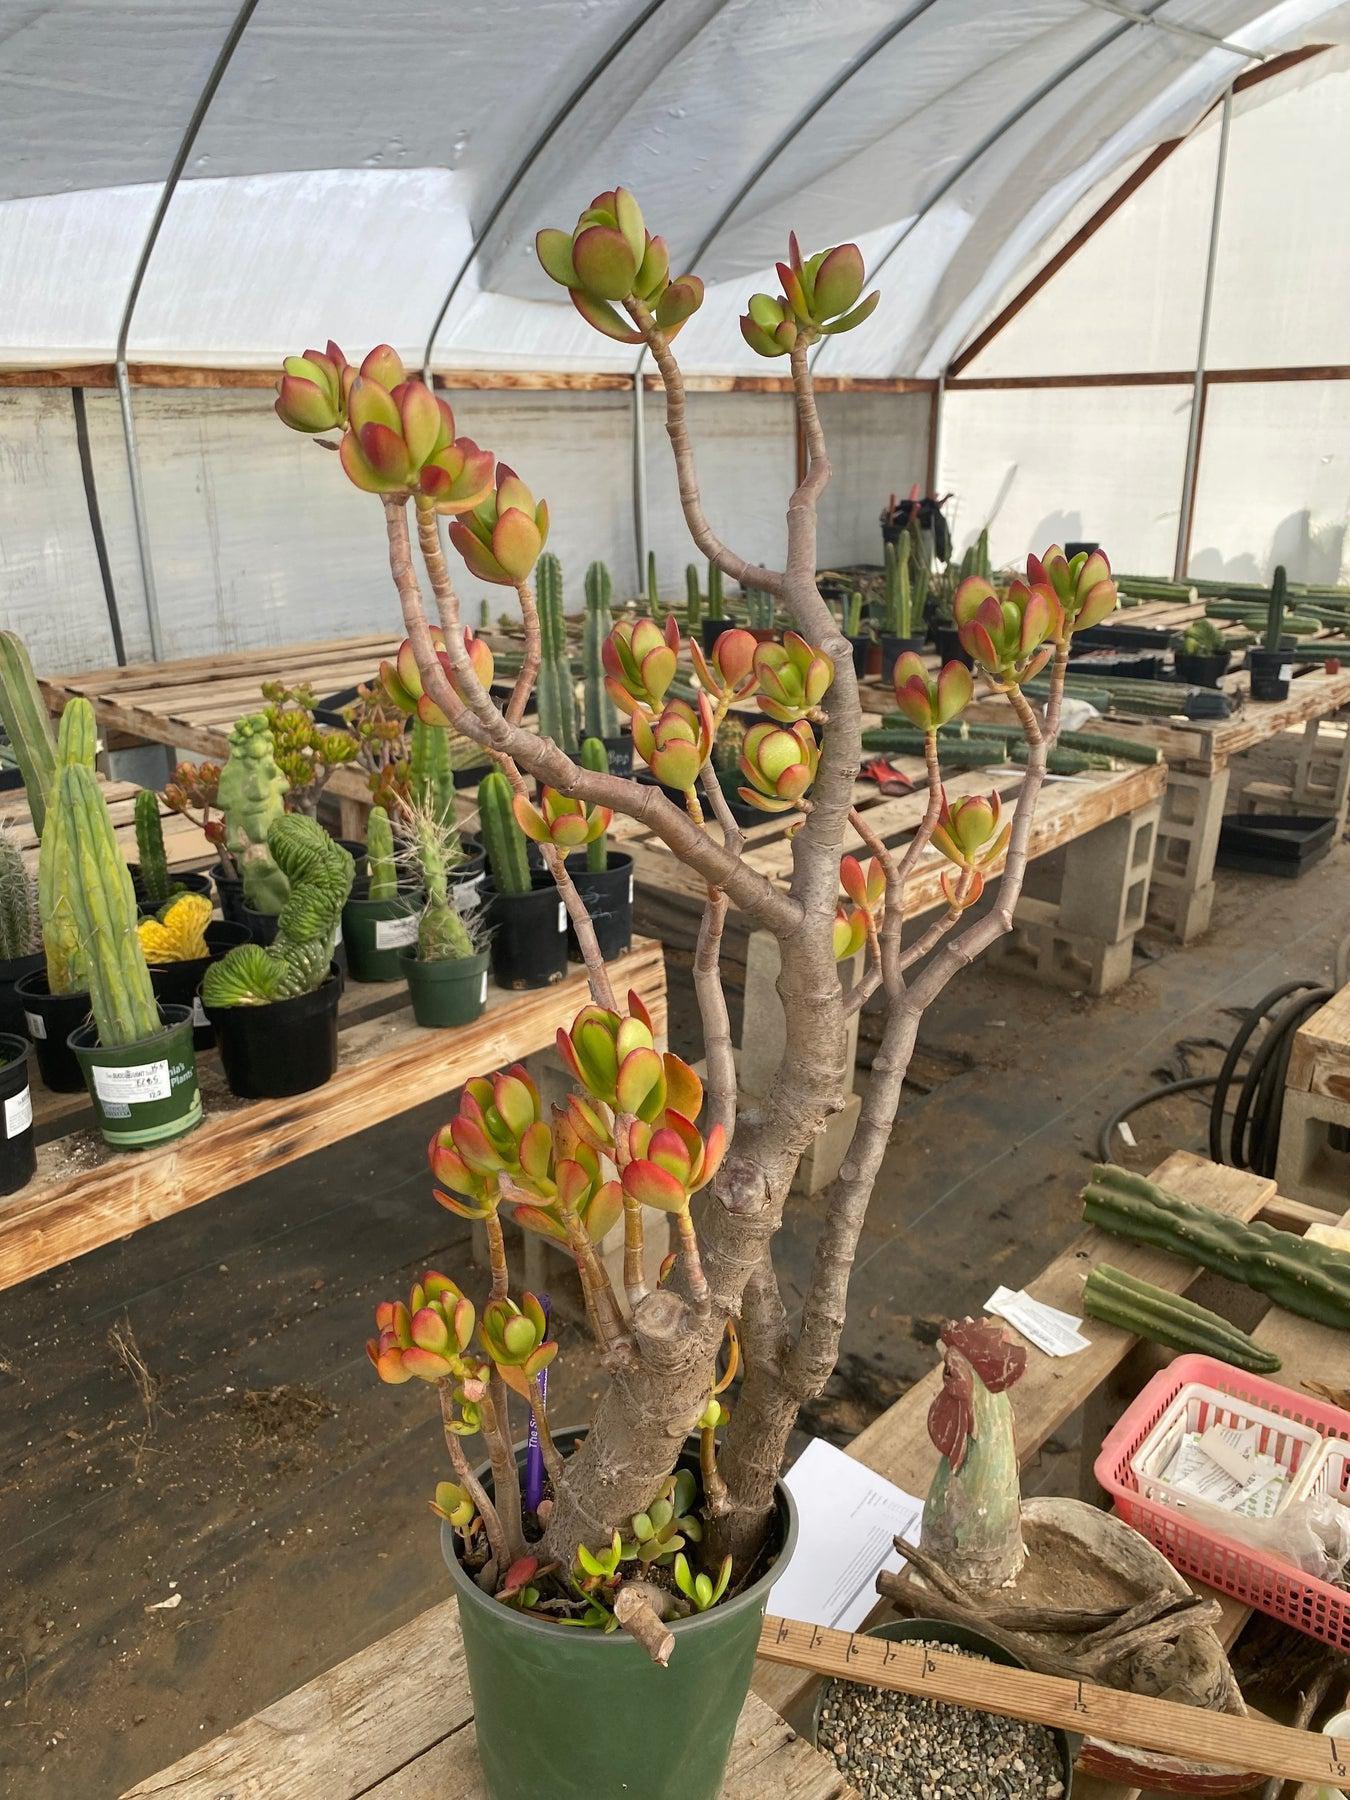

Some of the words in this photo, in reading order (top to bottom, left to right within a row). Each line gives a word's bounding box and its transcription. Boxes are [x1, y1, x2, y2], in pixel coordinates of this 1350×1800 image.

[528, 1430, 538, 1448] The
[815, 1636, 824, 1647] 5
[850, 1644, 859, 1655] 6
[889, 1653, 898, 1661] 7
[927, 1660, 936, 1672] 8
[1073, 1702, 1090, 1714] 12
[1328, 1762, 1347, 1777] 18
